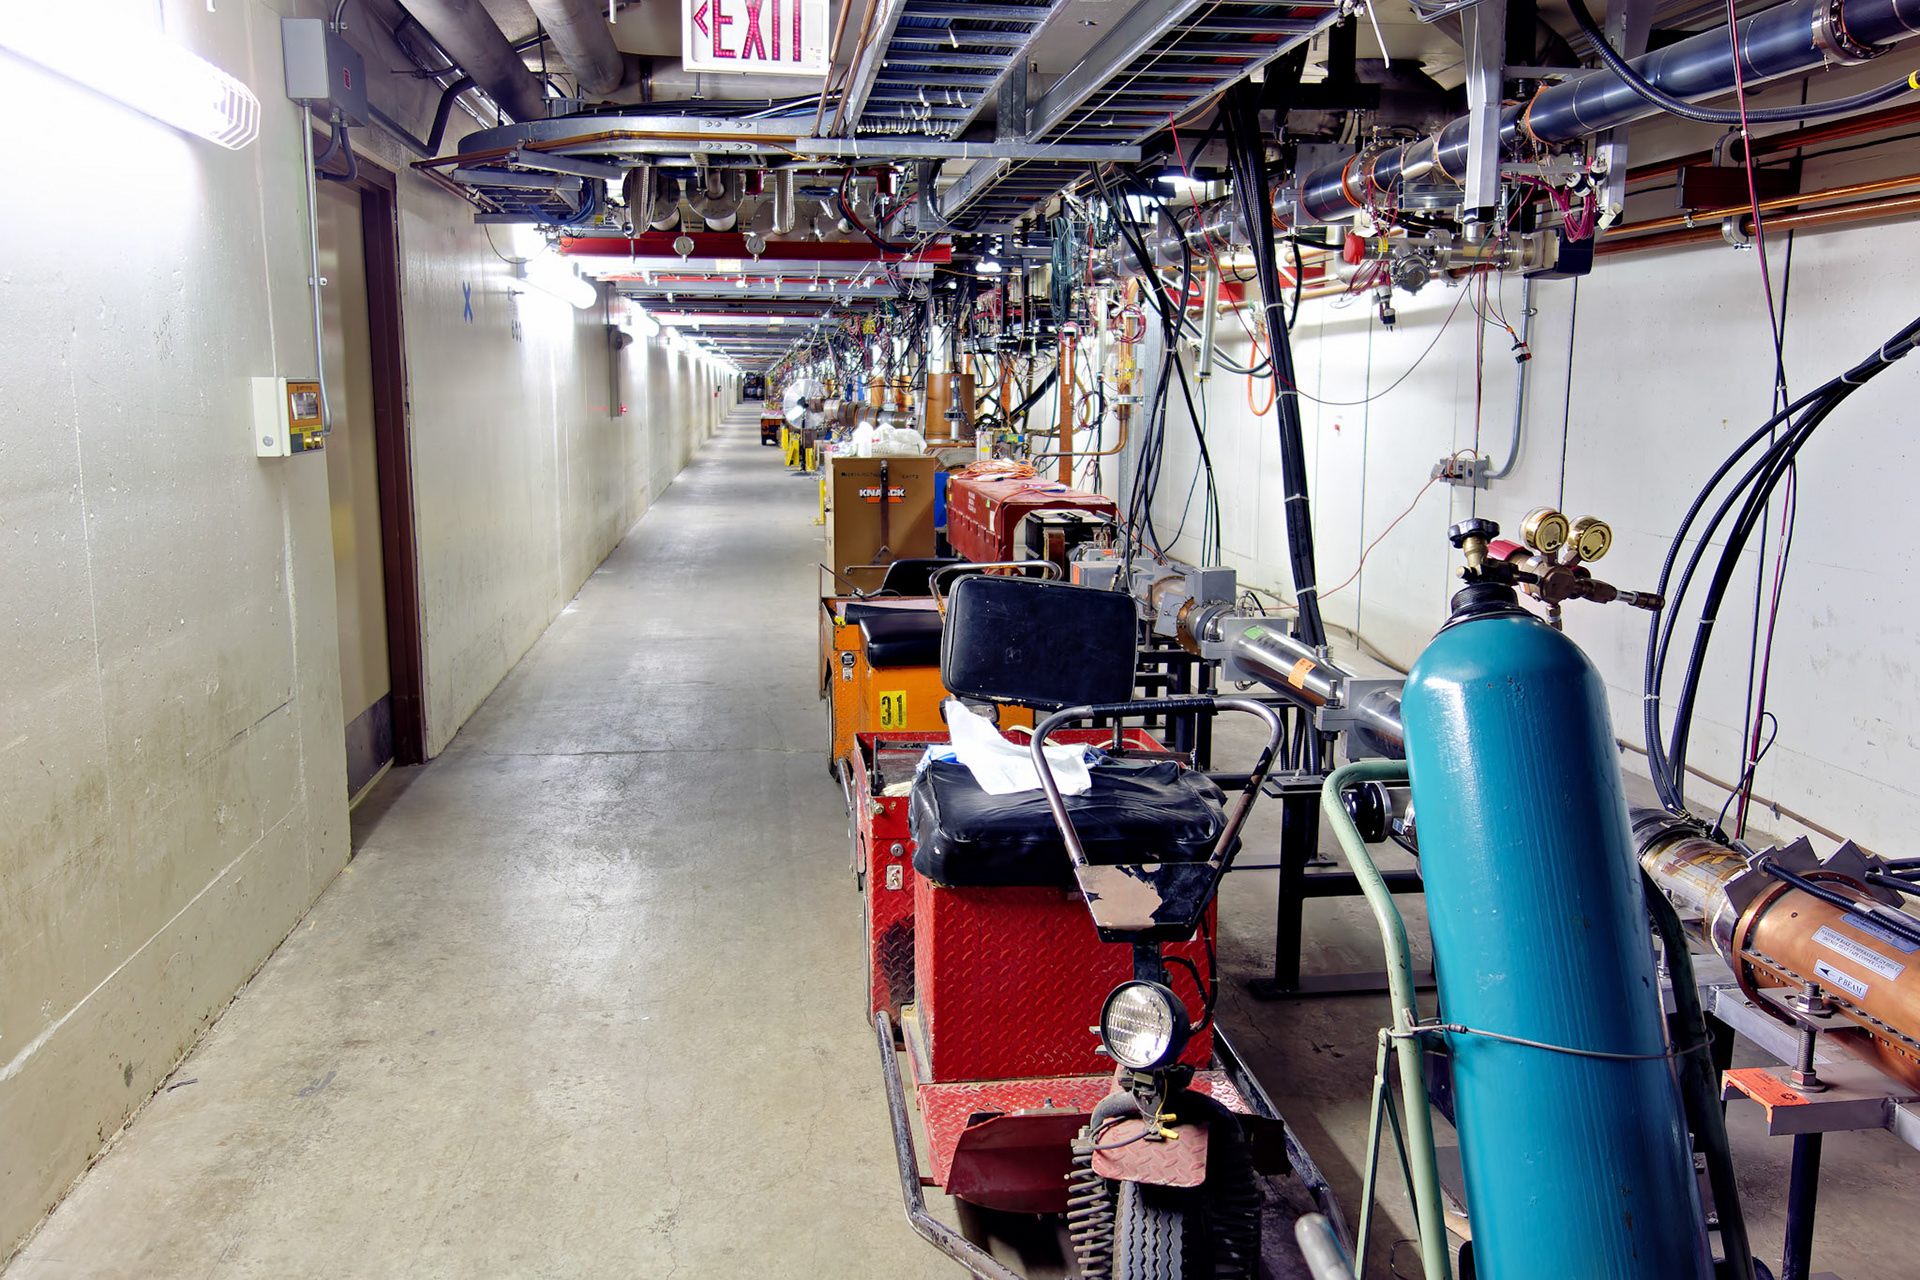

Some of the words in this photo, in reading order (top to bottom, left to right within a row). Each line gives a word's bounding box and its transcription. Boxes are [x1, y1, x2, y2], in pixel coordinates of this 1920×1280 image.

[713, 0, 801, 62] EXIT
[859, 488, 906, 498] KNACK
[881, 694, 903, 726] 31
